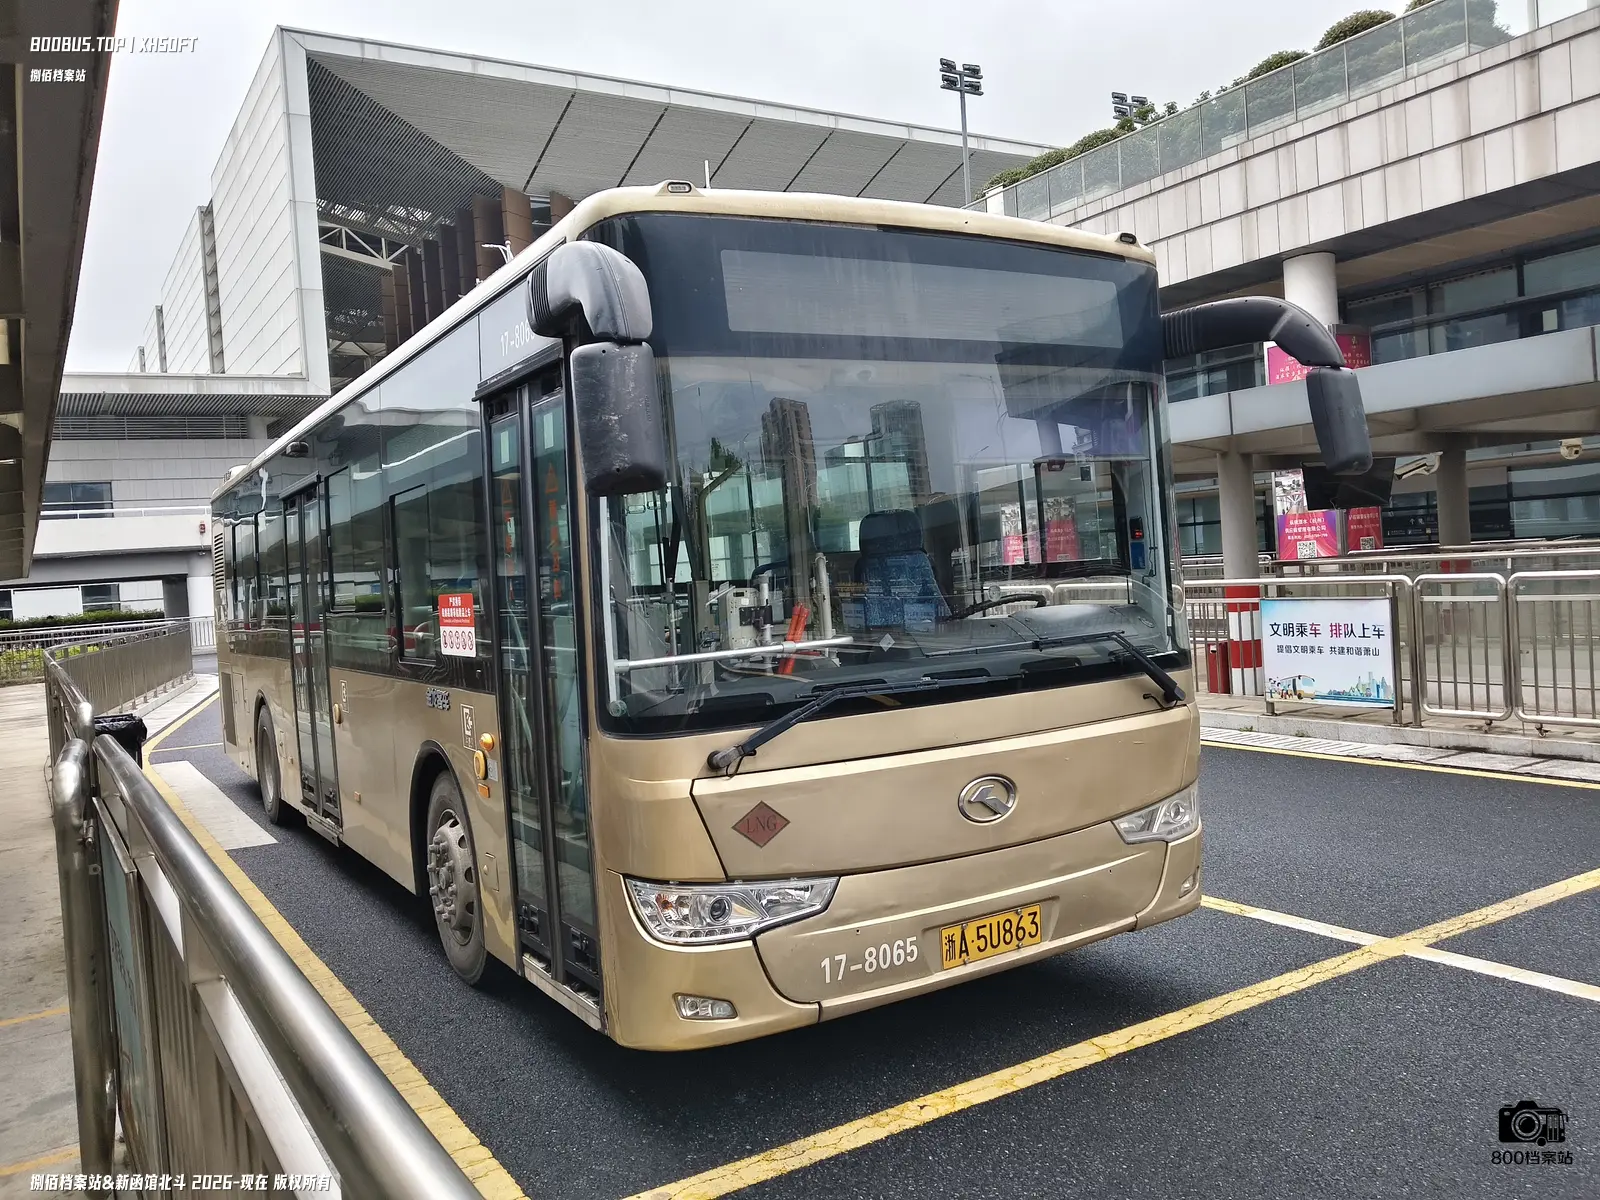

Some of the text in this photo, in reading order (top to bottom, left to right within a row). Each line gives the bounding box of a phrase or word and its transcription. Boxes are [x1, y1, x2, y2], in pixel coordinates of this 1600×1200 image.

[1269, 622, 1386, 639] 文明乘车 排队上车
[1276, 644, 1380, 657] 提倡文明乘车 共建和谐萧山
[745, 813, 778, 834] LNG
[820, 935, 919, 984] 17-8065
